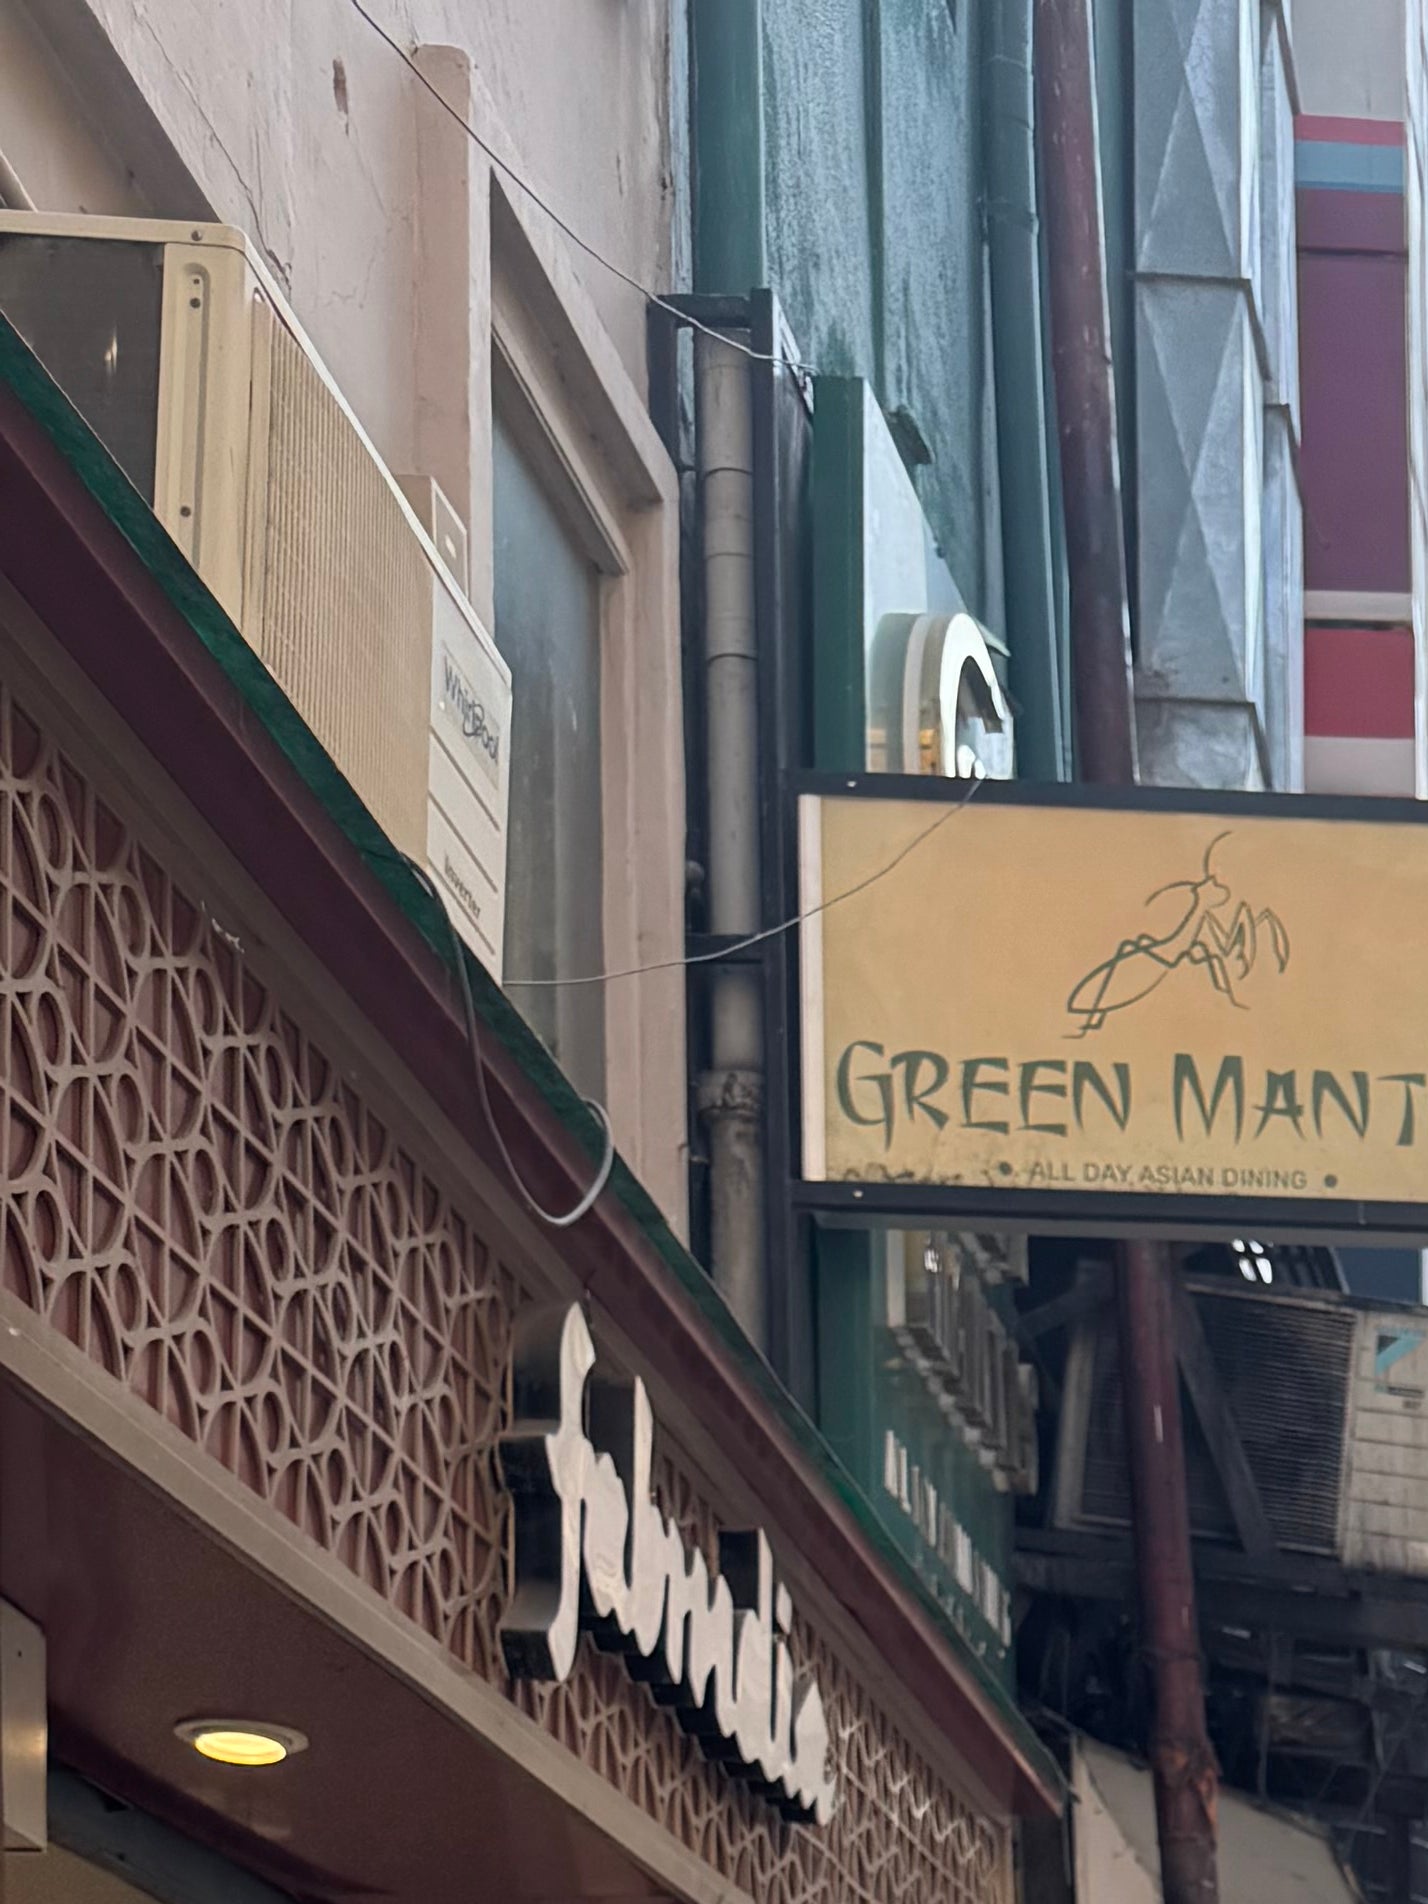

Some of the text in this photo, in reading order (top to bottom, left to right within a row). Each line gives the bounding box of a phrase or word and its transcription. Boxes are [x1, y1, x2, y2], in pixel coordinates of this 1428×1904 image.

[836, 1040, 1132, 1152] GREEN
[1030, 1161, 1308, 1190] ALL DAY ASIAN DINING
